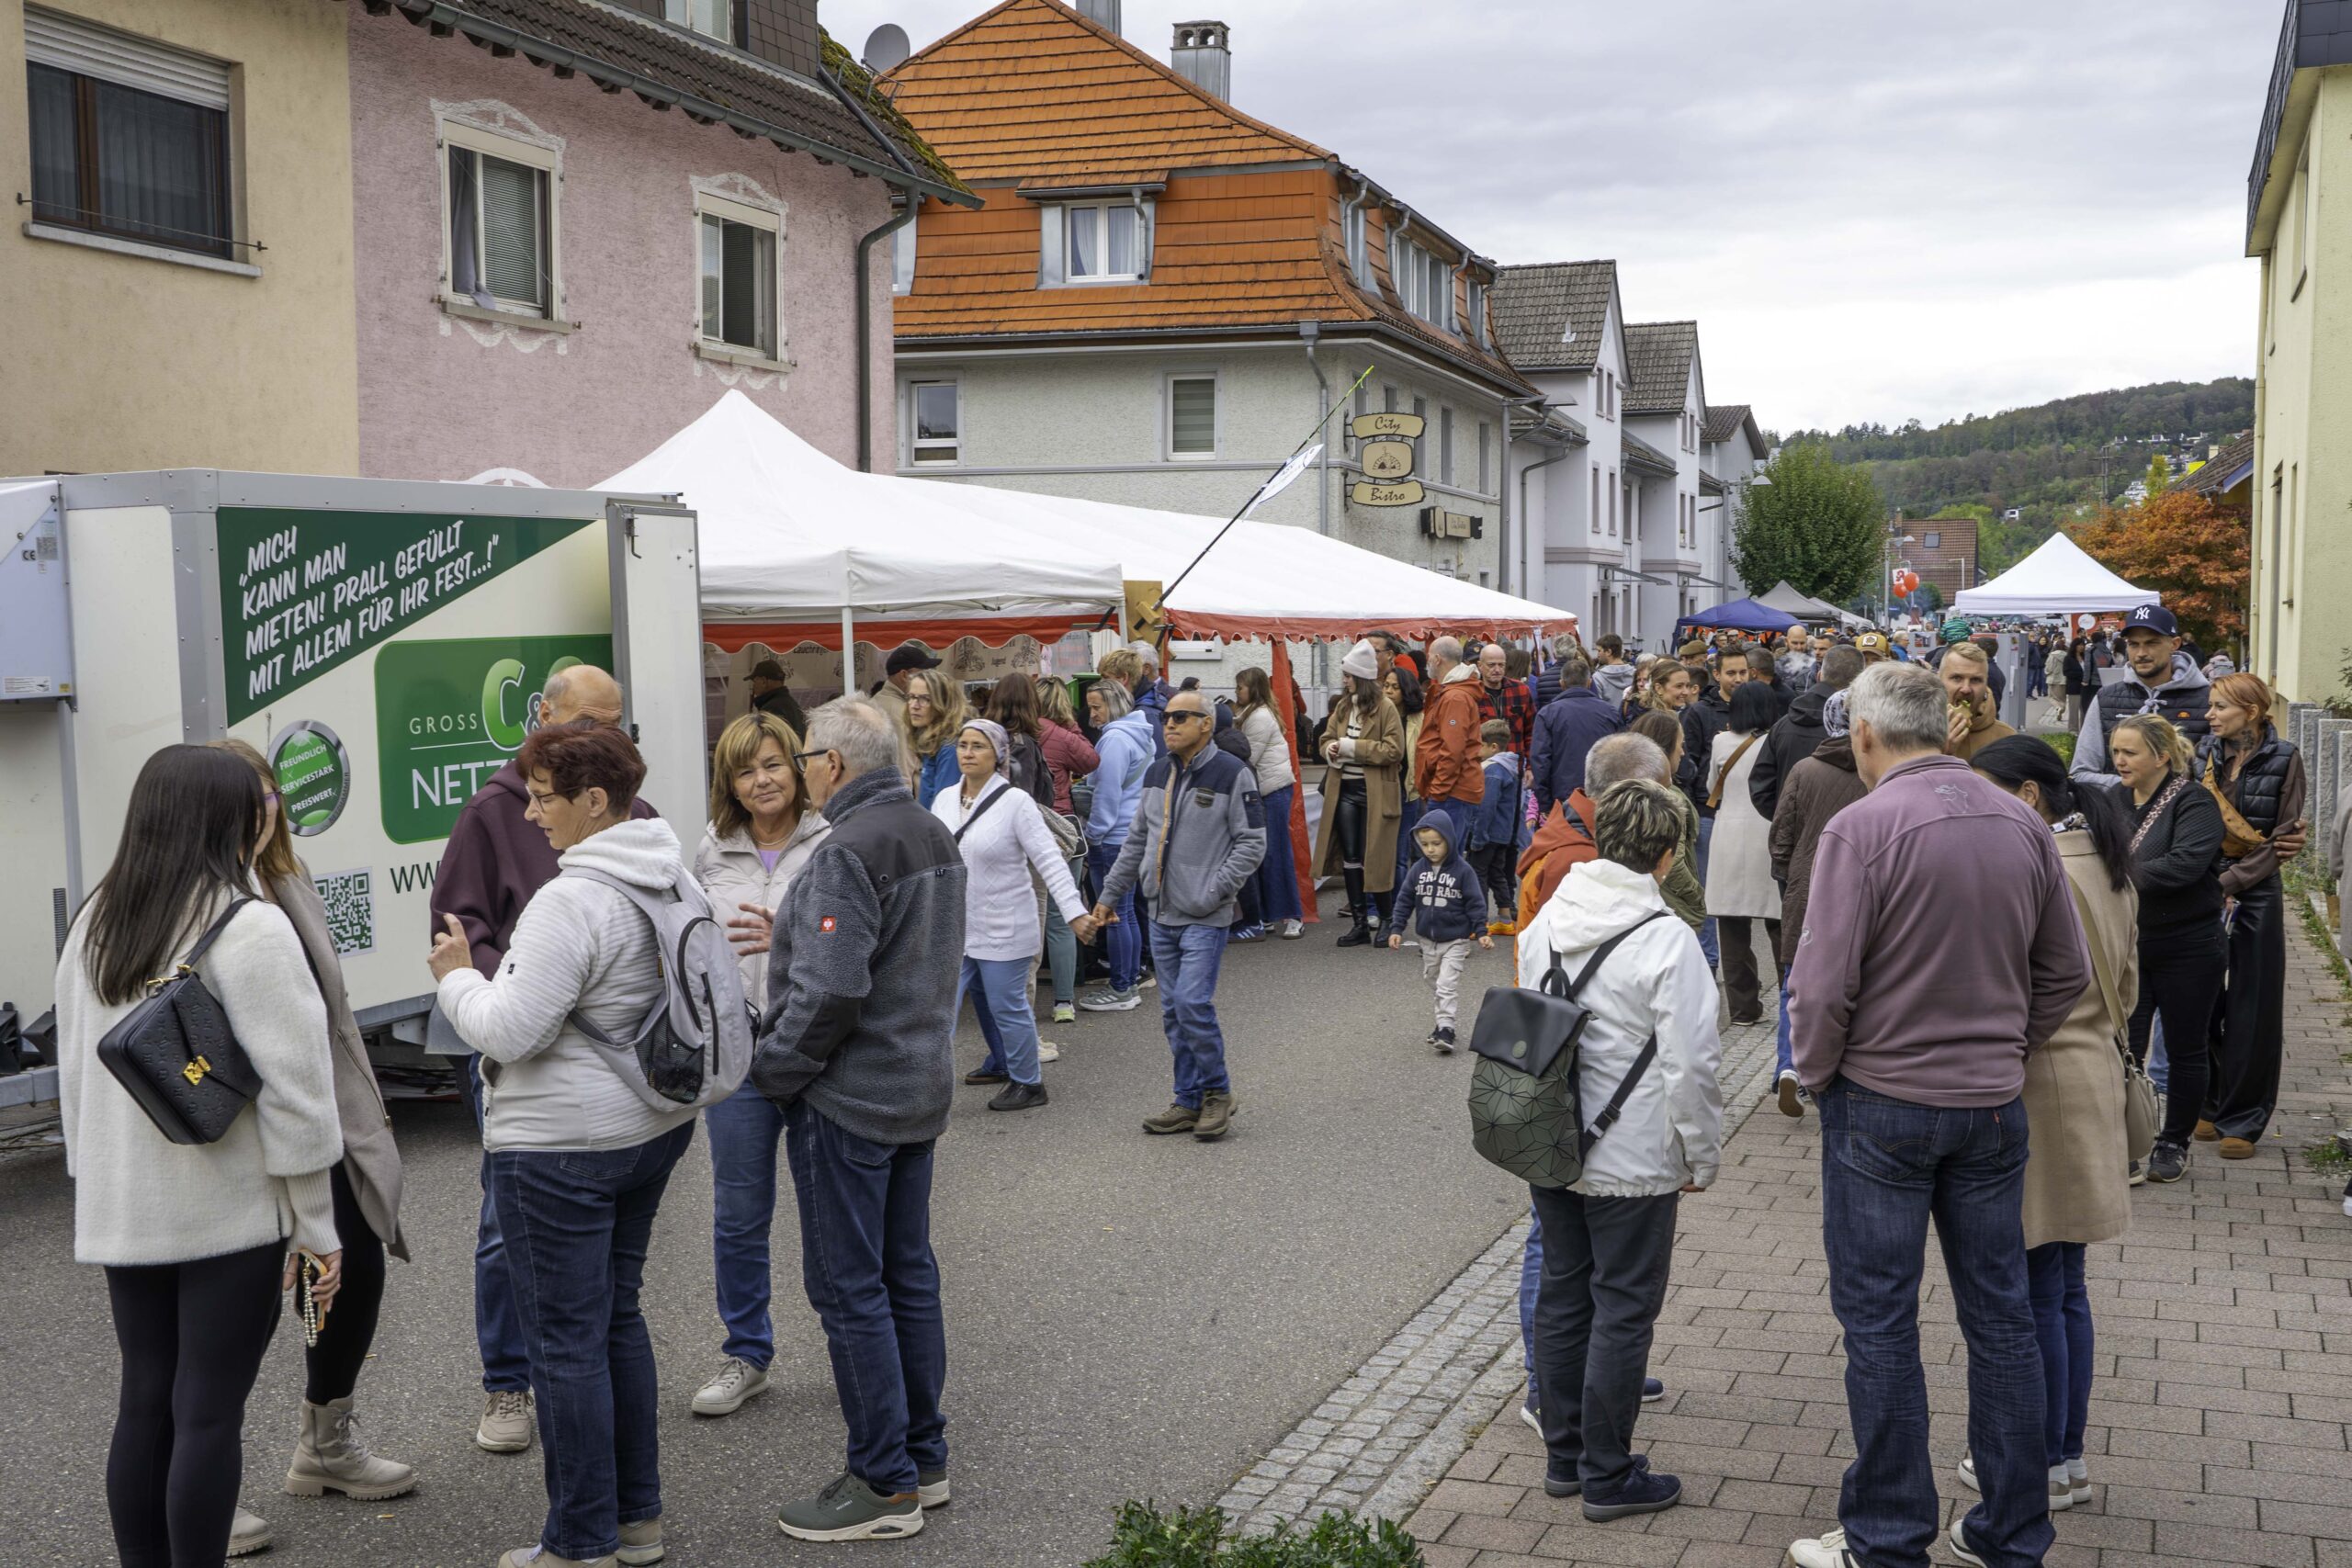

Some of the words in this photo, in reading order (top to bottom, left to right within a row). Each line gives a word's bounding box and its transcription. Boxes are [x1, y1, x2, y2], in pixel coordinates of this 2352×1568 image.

[1374, 416, 1402, 434] City
[1370, 487, 1406, 502] Bistro
[243, 567, 297, 620] KANN
[304, 542, 346, 589] MAN
[245, 592, 325, 660] MIETEN!
[334, 560, 390, 613] PRALL
[395, 520, 463, 580] GEFÜLLT
[249, 653, 286, 700] MIT
[292, 618, 352, 676] ALLEM
[358, 597, 393, 638] FÜR
[400, 578, 429, 616] IHR
[409, 713, 478, 735] GROSS
[279, 744, 327, 771] FREUNDLICH
[280, 764, 335, 795] SERVICESTARK
[291, 787, 333, 814] PREISWERT
